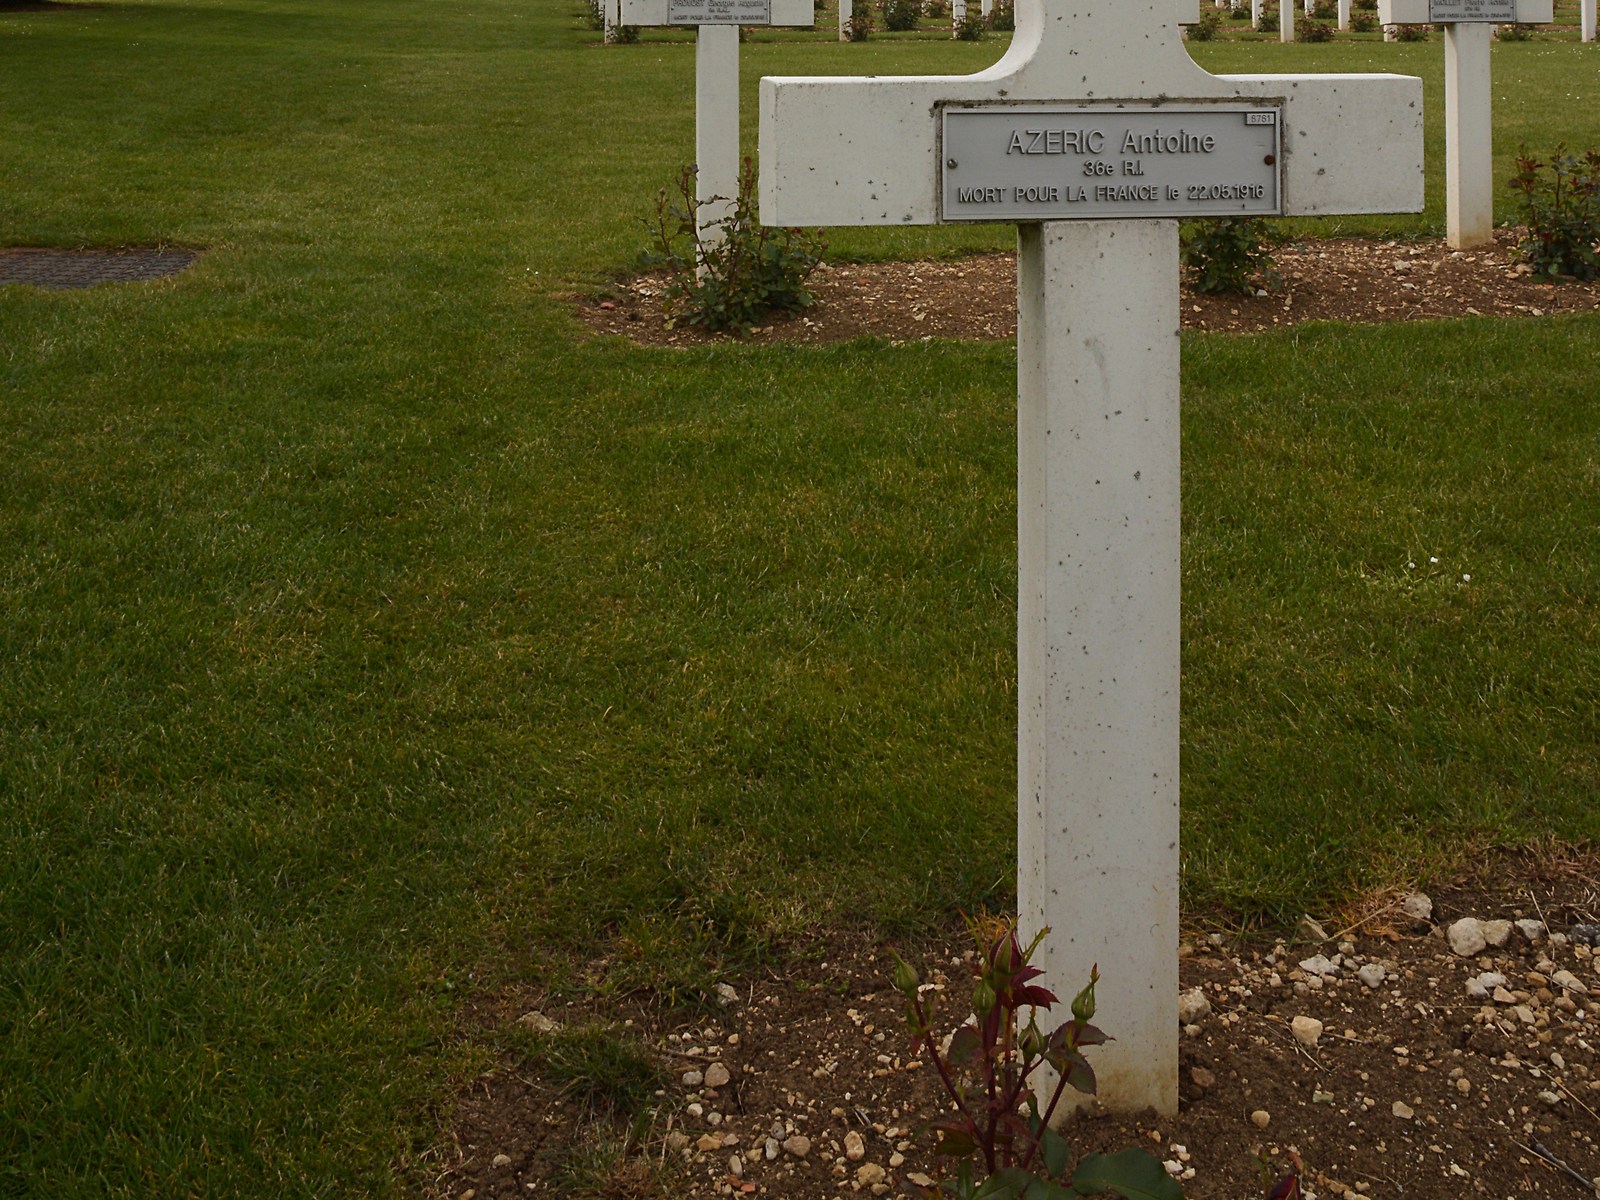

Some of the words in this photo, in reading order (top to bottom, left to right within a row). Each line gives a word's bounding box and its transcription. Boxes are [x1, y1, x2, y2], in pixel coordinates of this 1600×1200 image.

[1006, 129, 1105, 154] AZERIC
[1120, 128, 1215, 153] Antoine
[1083, 159, 1114, 176] 36e
[958, 186, 1006, 203] MORT
[1014, 186, 1059, 202] POUR
[1066, 185, 1087, 202] LA
[1095, 185, 1158, 201] FRANCE
[1166, 184, 1180, 200] le
[1187, 183, 1265, 200] 22.05.1916
